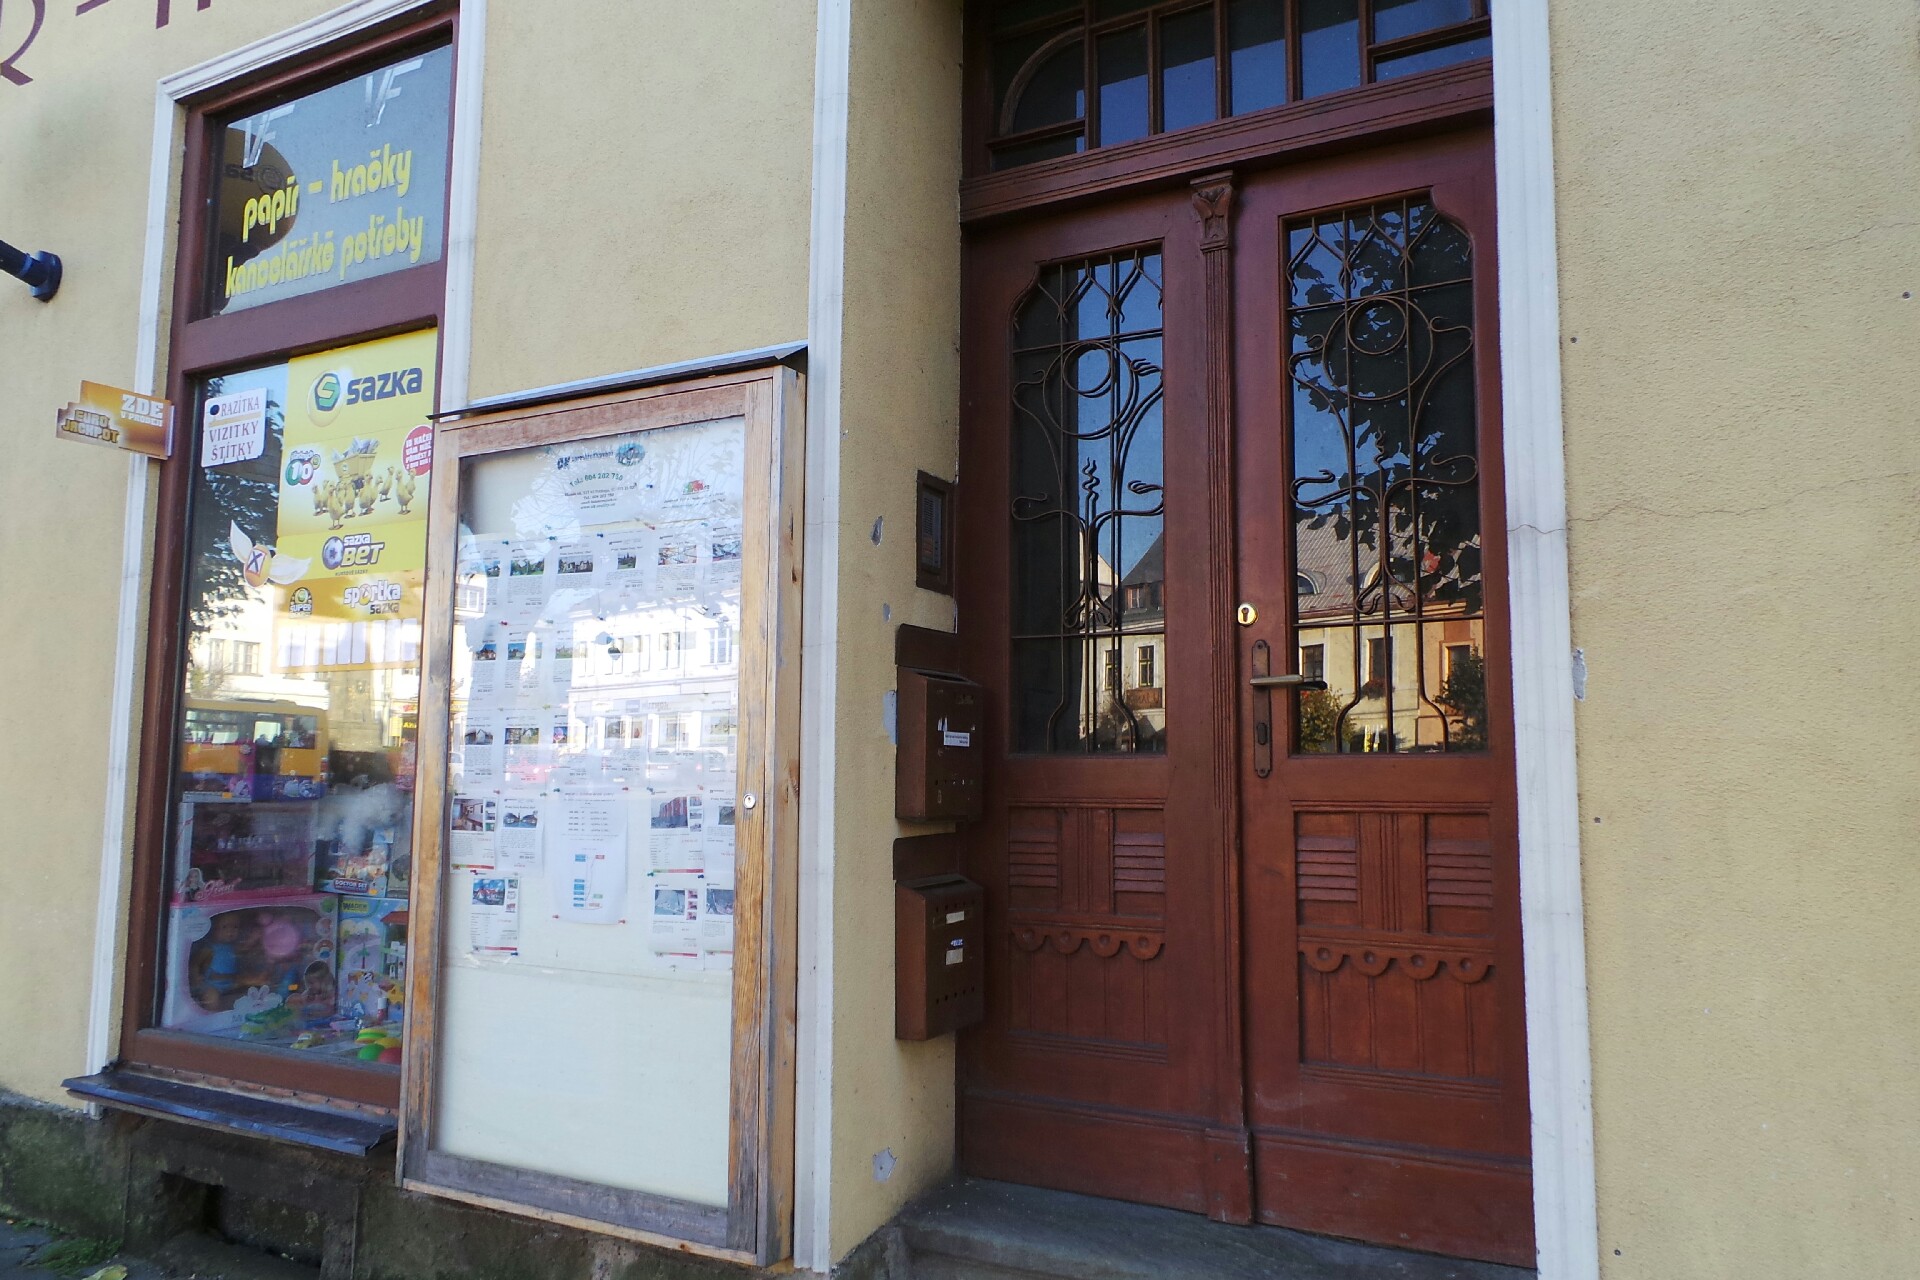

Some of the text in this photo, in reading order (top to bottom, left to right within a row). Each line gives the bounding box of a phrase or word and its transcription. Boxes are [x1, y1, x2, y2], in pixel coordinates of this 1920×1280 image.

[242, 175, 299, 243] papír
[330, 143, 412, 203] hračky
[340, 206, 424, 281] potřeby
[121, 394, 163, 419] ZDE
[221, 395, 260, 416] RAZÍTKA
[61, 419, 120, 443] JACKPOT
[74, 410, 110, 428] EURO
[209, 420, 259, 443] VIZITKY
[211, 441, 254, 461] ŠTÍTKY
[343, 580, 401, 608] sportka
